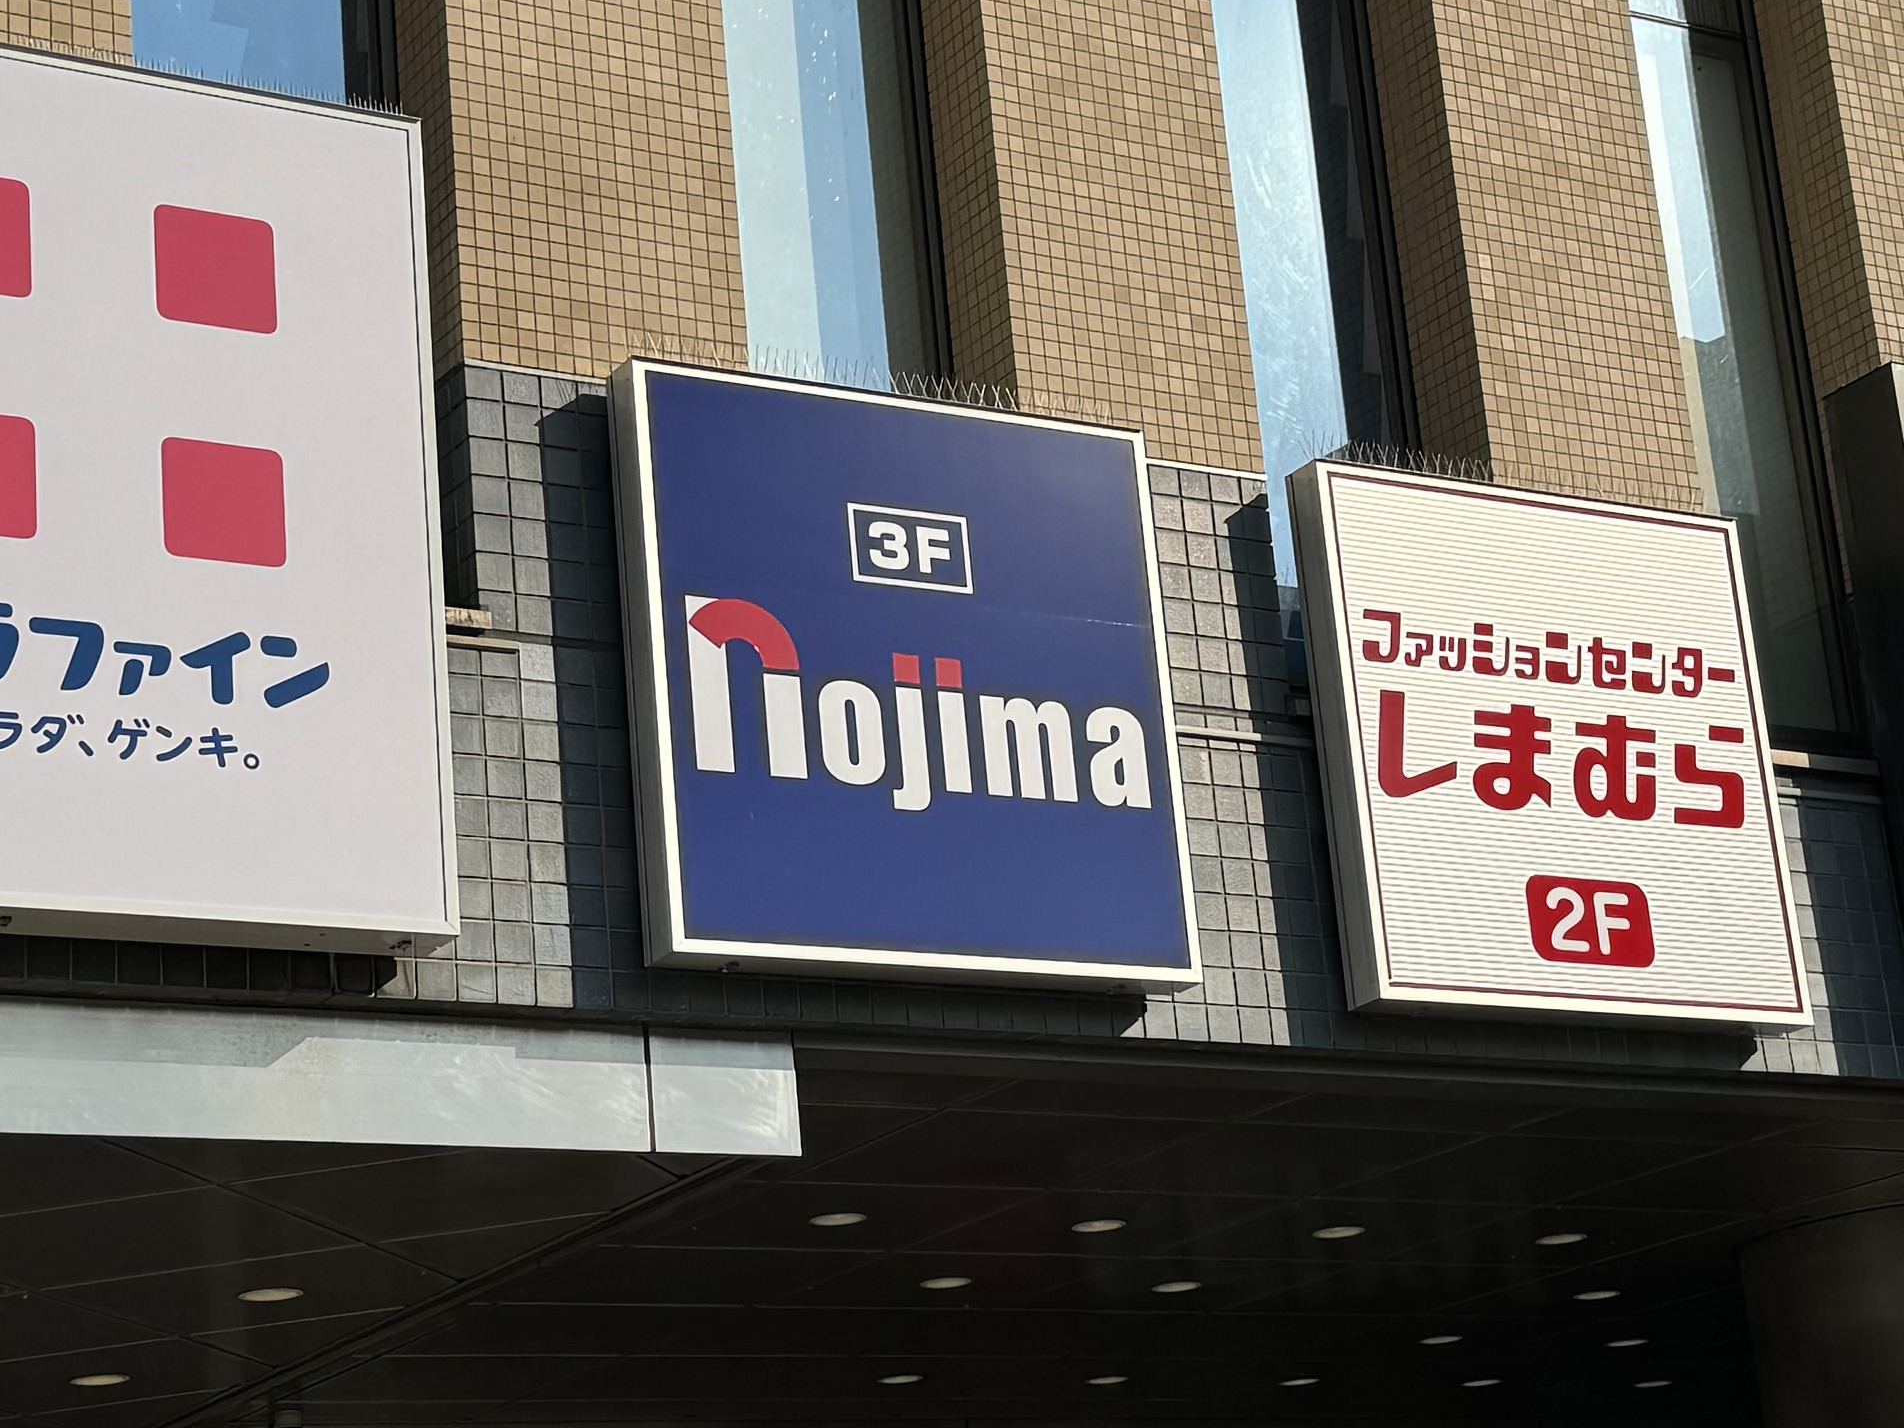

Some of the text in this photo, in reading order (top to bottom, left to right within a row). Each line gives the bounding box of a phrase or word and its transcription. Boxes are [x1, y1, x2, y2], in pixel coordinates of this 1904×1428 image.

[867, 519, 952, 575] 3F
[1362, 608, 1736, 699] ファッションセンター
[684, 594, 1153, 811] nojima
[1376, 689, 1745, 830] しまむら
[1545, 886, 1631, 956] 2F
